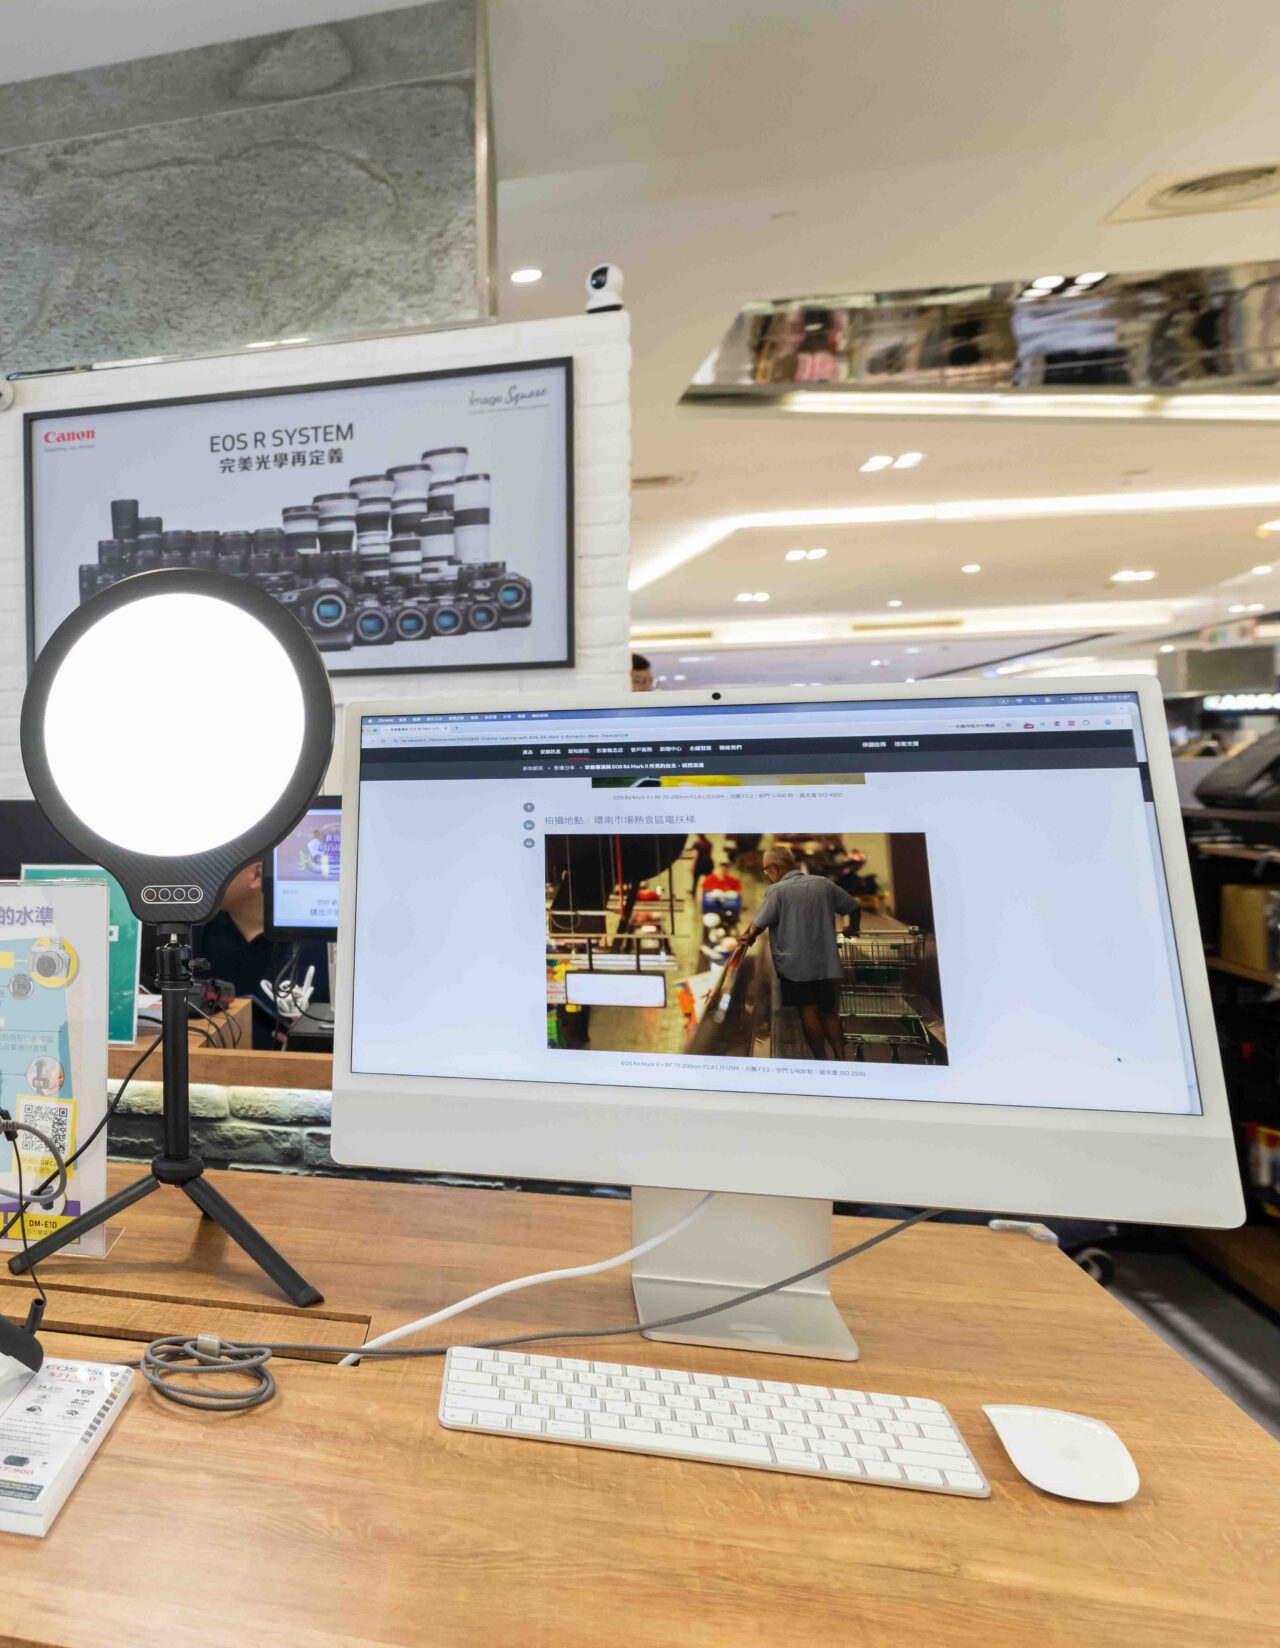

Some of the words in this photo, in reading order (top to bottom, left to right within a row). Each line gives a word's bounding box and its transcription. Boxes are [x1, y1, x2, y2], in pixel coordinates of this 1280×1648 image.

[44, 429, 95, 443] Canon
[210, 433, 248, 453] EOS
[253, 431, 266, 449] R
[272, 423, 354, 447] SYSTEM
[219, 447, 344, 474] 完美光學再定義
[29, 1220, 58, 1229] DM-E1D
